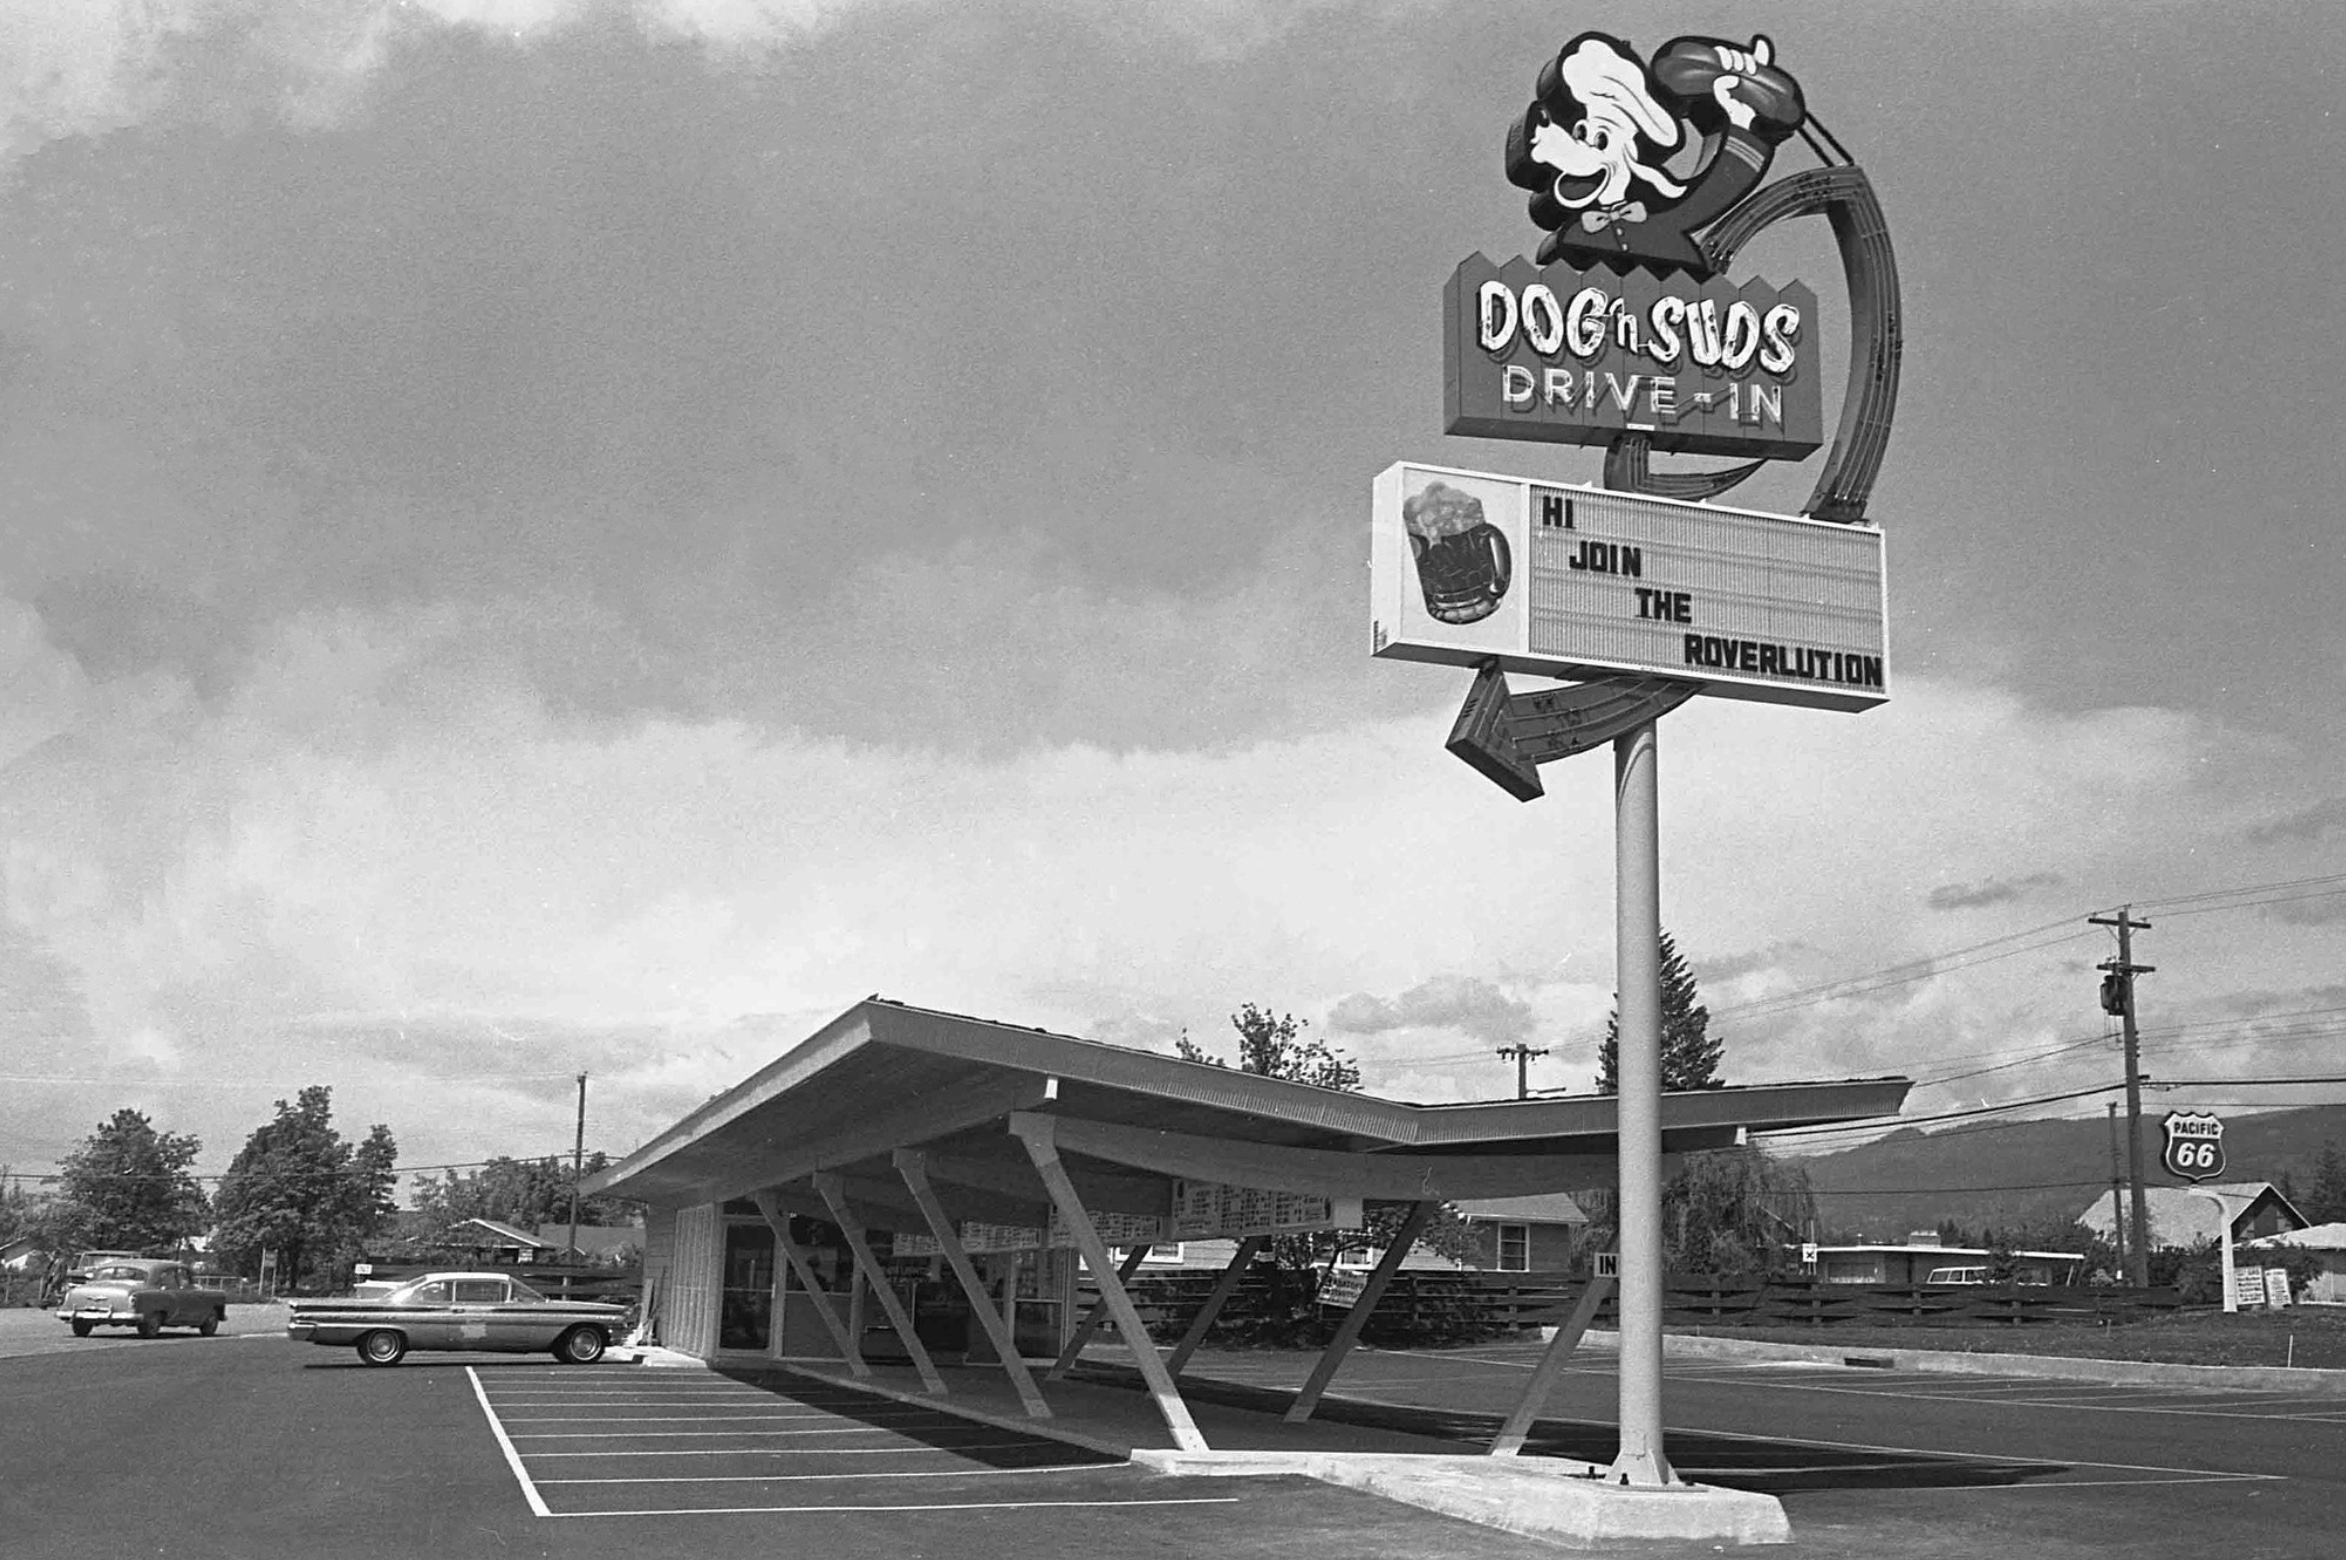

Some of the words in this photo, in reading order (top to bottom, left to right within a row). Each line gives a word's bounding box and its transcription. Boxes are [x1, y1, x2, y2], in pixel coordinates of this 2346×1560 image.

[1479, 280, 1608, 357] DOG
[1650, 295, 1800, 373] SUDS
[1502, 365, 1782, 423] DRIVE-IN
[1542, 496, 1574, 529] HI
[1569, 541, 1641, 577] JOIN
[1635, 588, 1692, 624] THE
[1685, 634, 1883, 686] ROVERLUTION
[2174, 1122, 2218, 1135] PACIFIC
[2177, 1142, 2216, 1167] 66
[1599, 1255, 1616, 1275] IN
